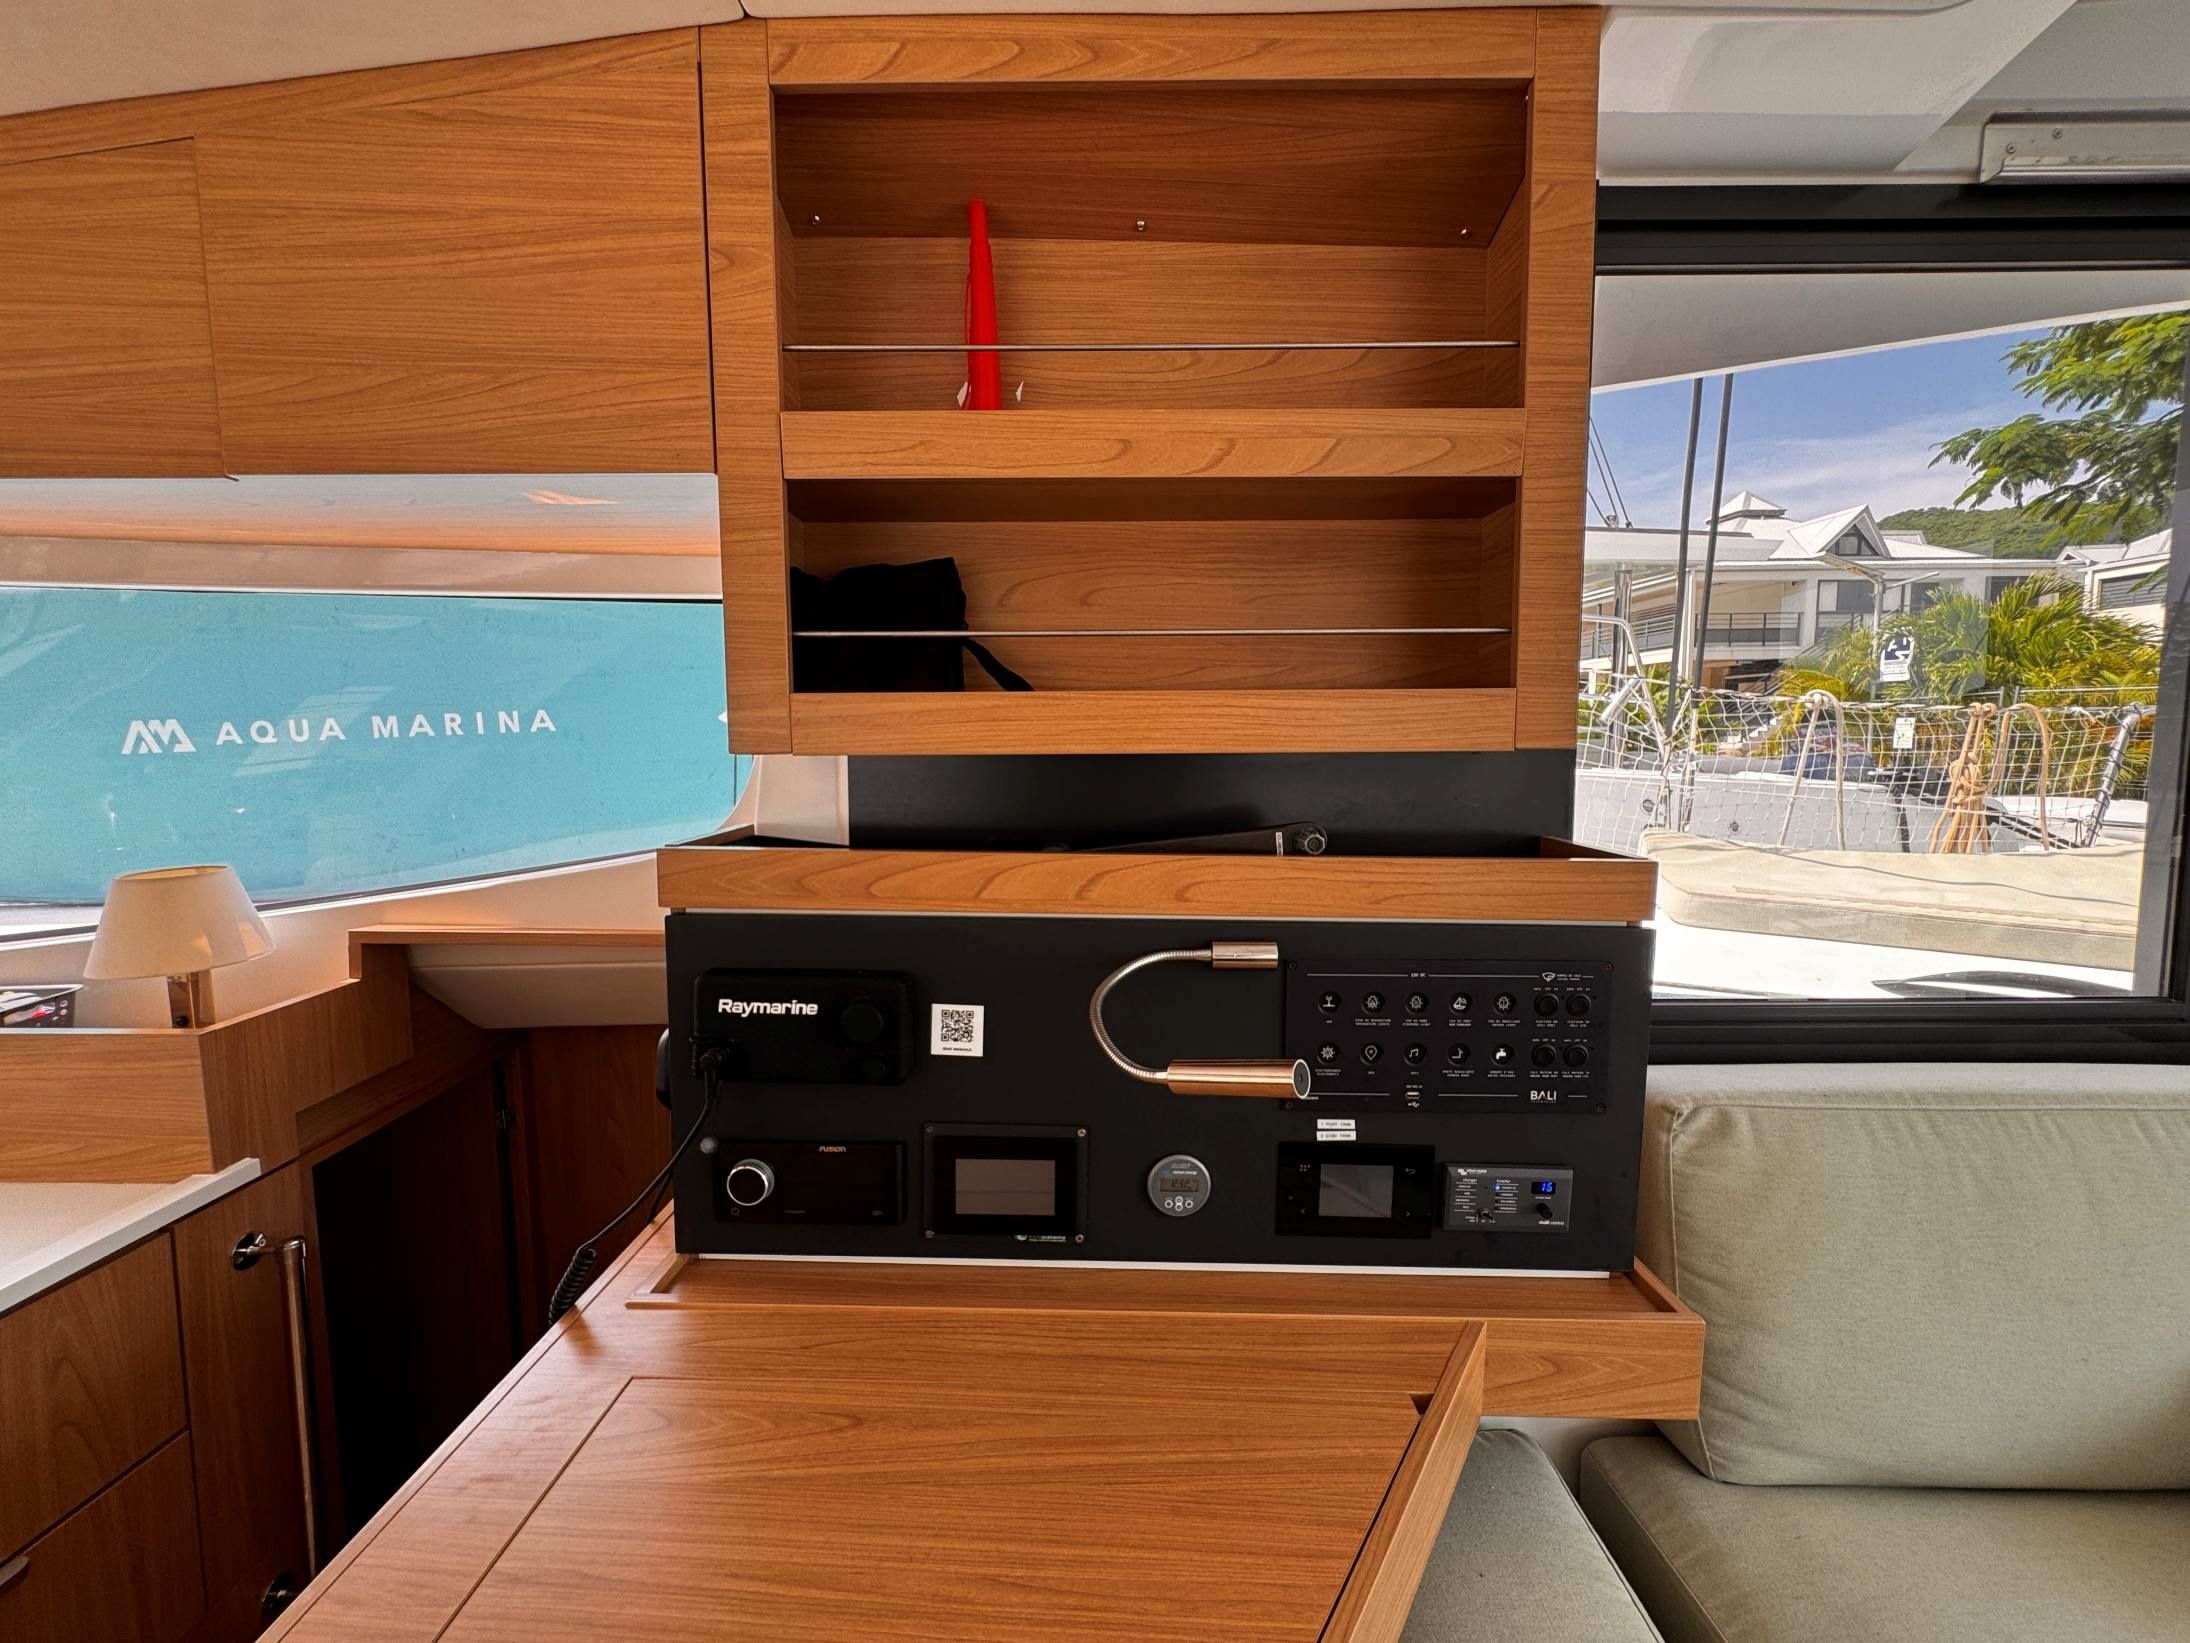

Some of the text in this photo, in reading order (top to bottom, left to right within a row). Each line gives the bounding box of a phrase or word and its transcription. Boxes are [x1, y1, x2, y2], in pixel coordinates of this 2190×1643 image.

[216, 717, 346, 746] AQUA
[372, 709, 557, 739] MARINA
[718, 998, 819, 1018] Raymarine
[1530, 1090, 1557, 1101] BALI
